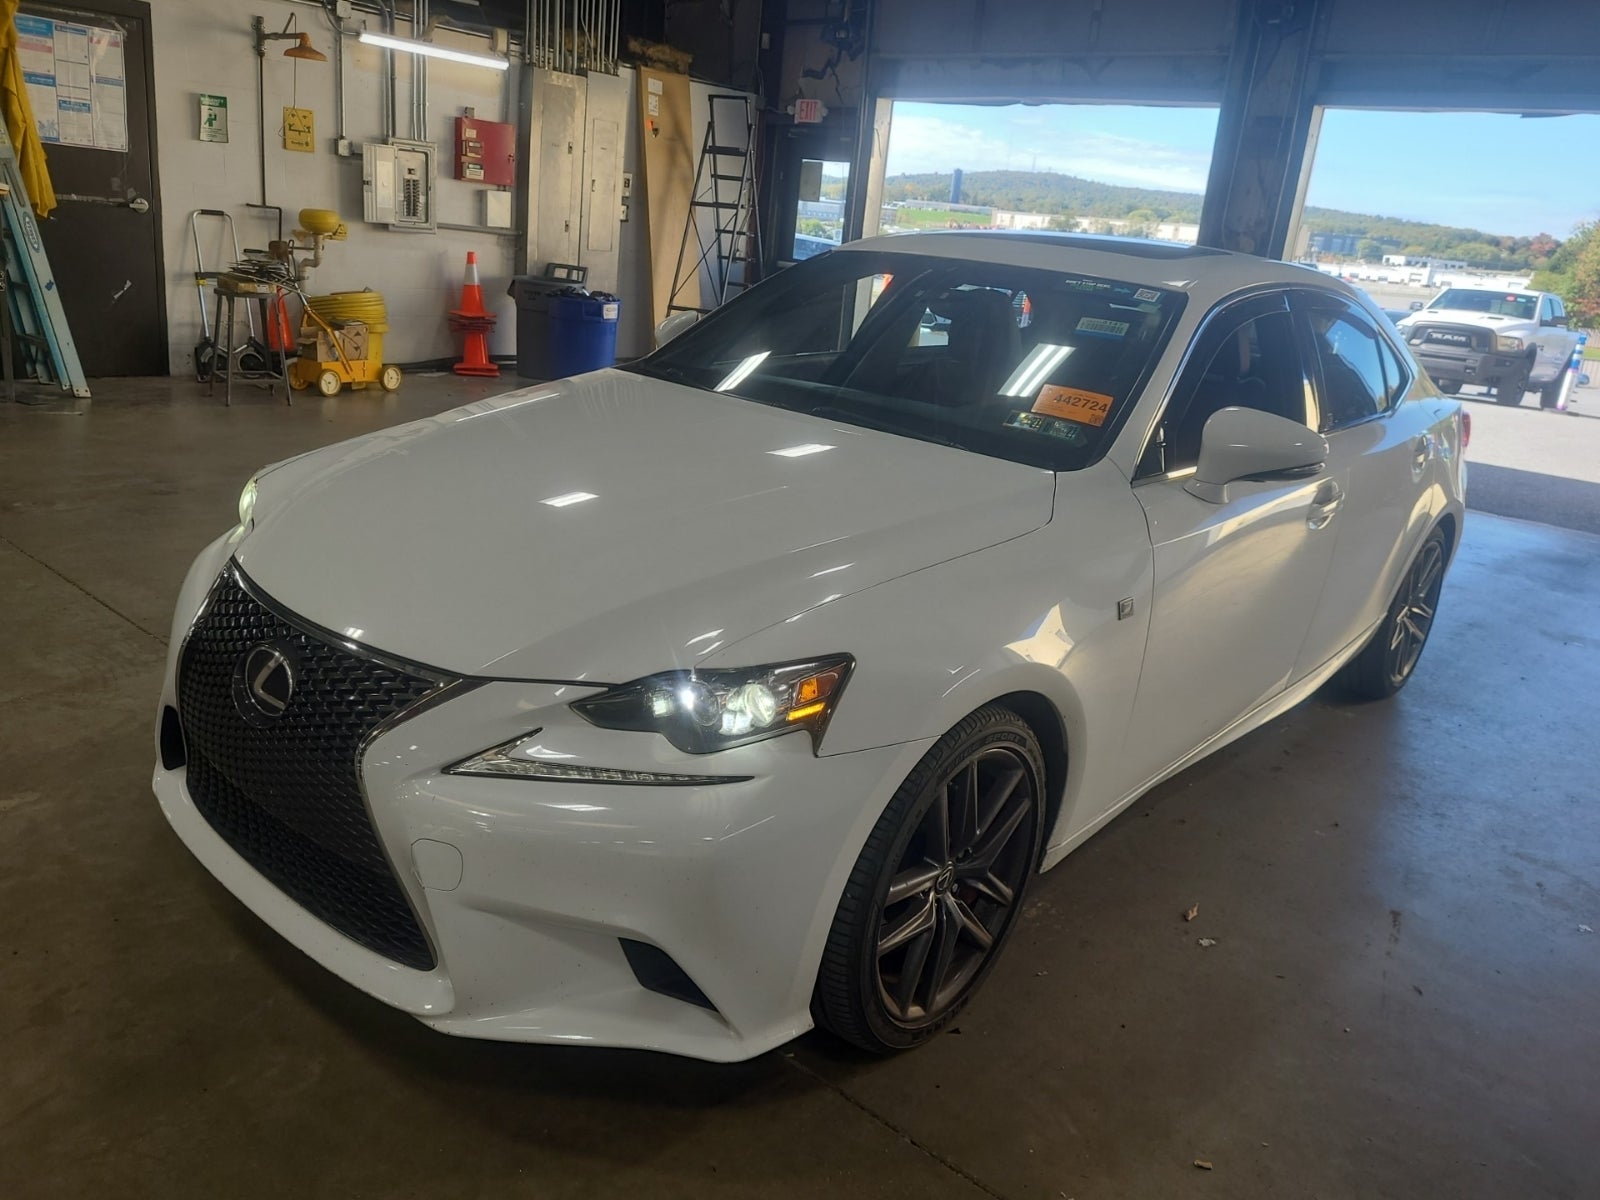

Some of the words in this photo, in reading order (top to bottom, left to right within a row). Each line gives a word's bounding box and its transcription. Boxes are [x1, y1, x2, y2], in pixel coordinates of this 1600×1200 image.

[799, 101, 819, 121] EXIT
[1430, 332, 1468, 343] RAM
[1054, 393, 1108, 413] 442724
[985, 730, 1021, 745] SPORT
